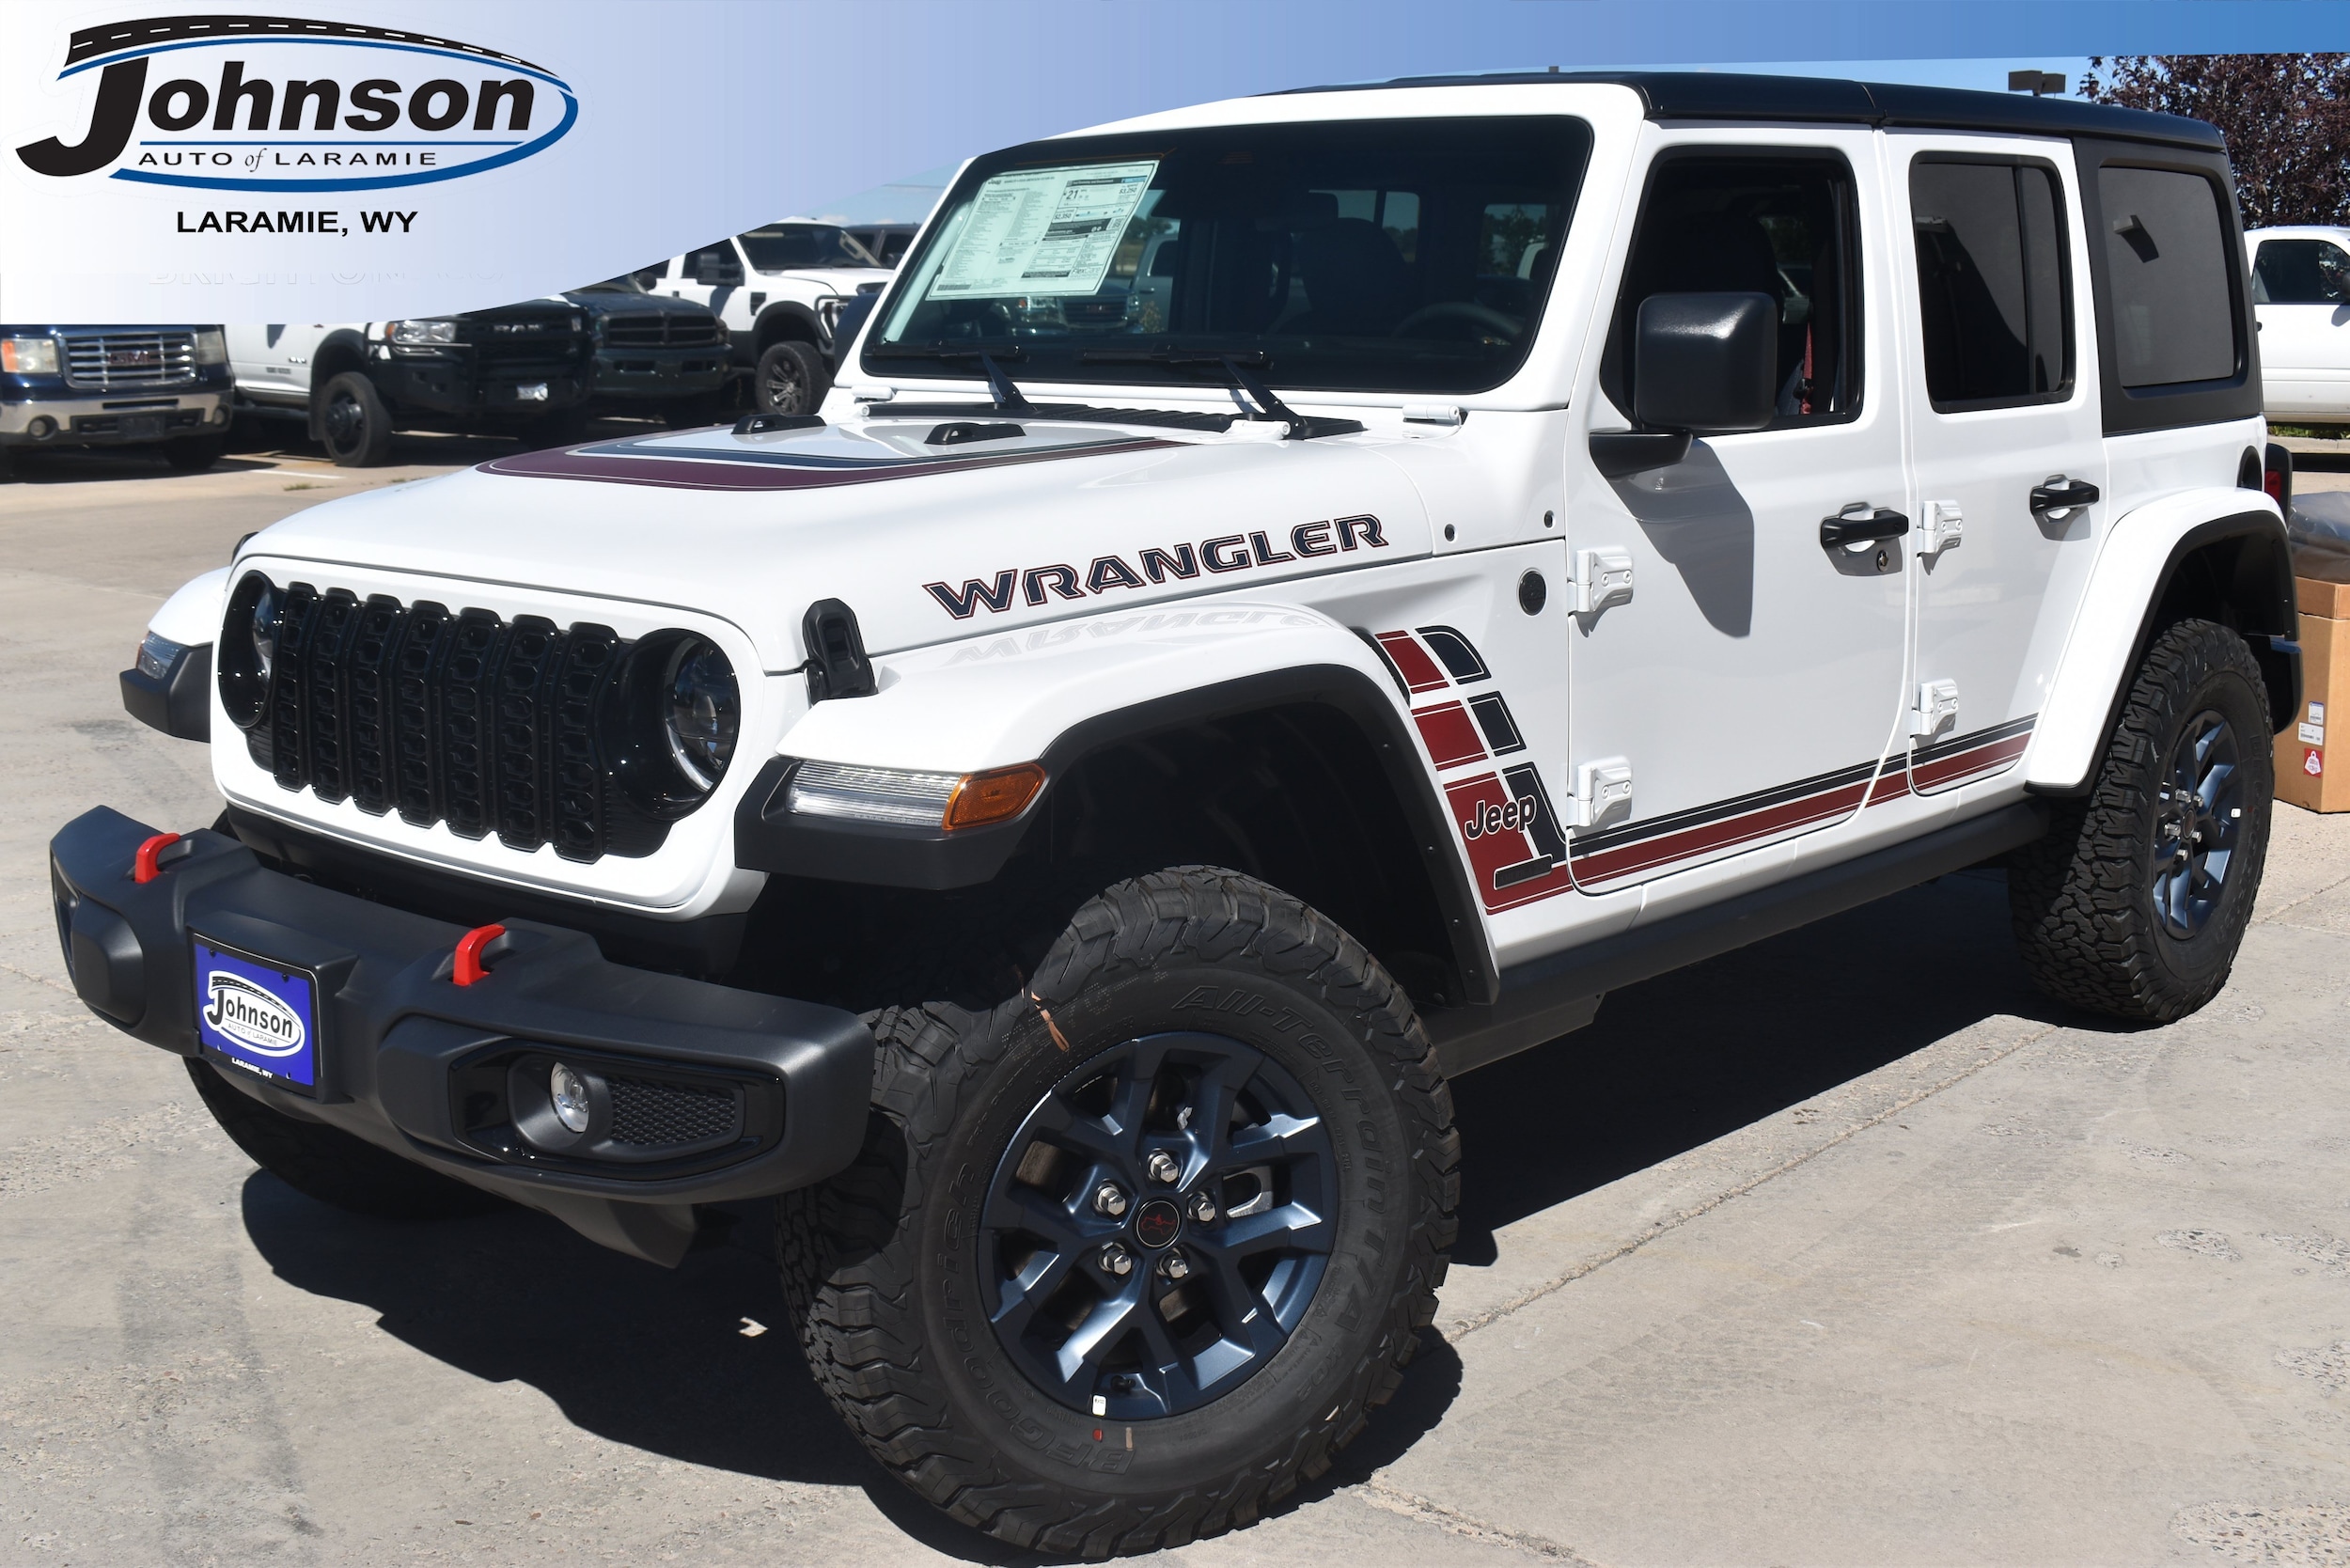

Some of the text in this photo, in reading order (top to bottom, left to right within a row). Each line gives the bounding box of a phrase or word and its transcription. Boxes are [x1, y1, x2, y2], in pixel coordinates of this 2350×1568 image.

[1066, 190, 1078, 199] 21
[921, 513, 1389, 619] WRANGLER
[1464, 794, 1537, 840] Jeep
[207, 990, 292, 1038] Johnson
[227, 1023, 246, 1034] AUTO
[252, 1032, 278, 1046] LARAMIE
[231, 1057, 274, 1079] LARAMIE, WY
[1171, 984, 1391, 1215] All-Terrain
[936, 1161, 1136, 1476] BFGoodrich
